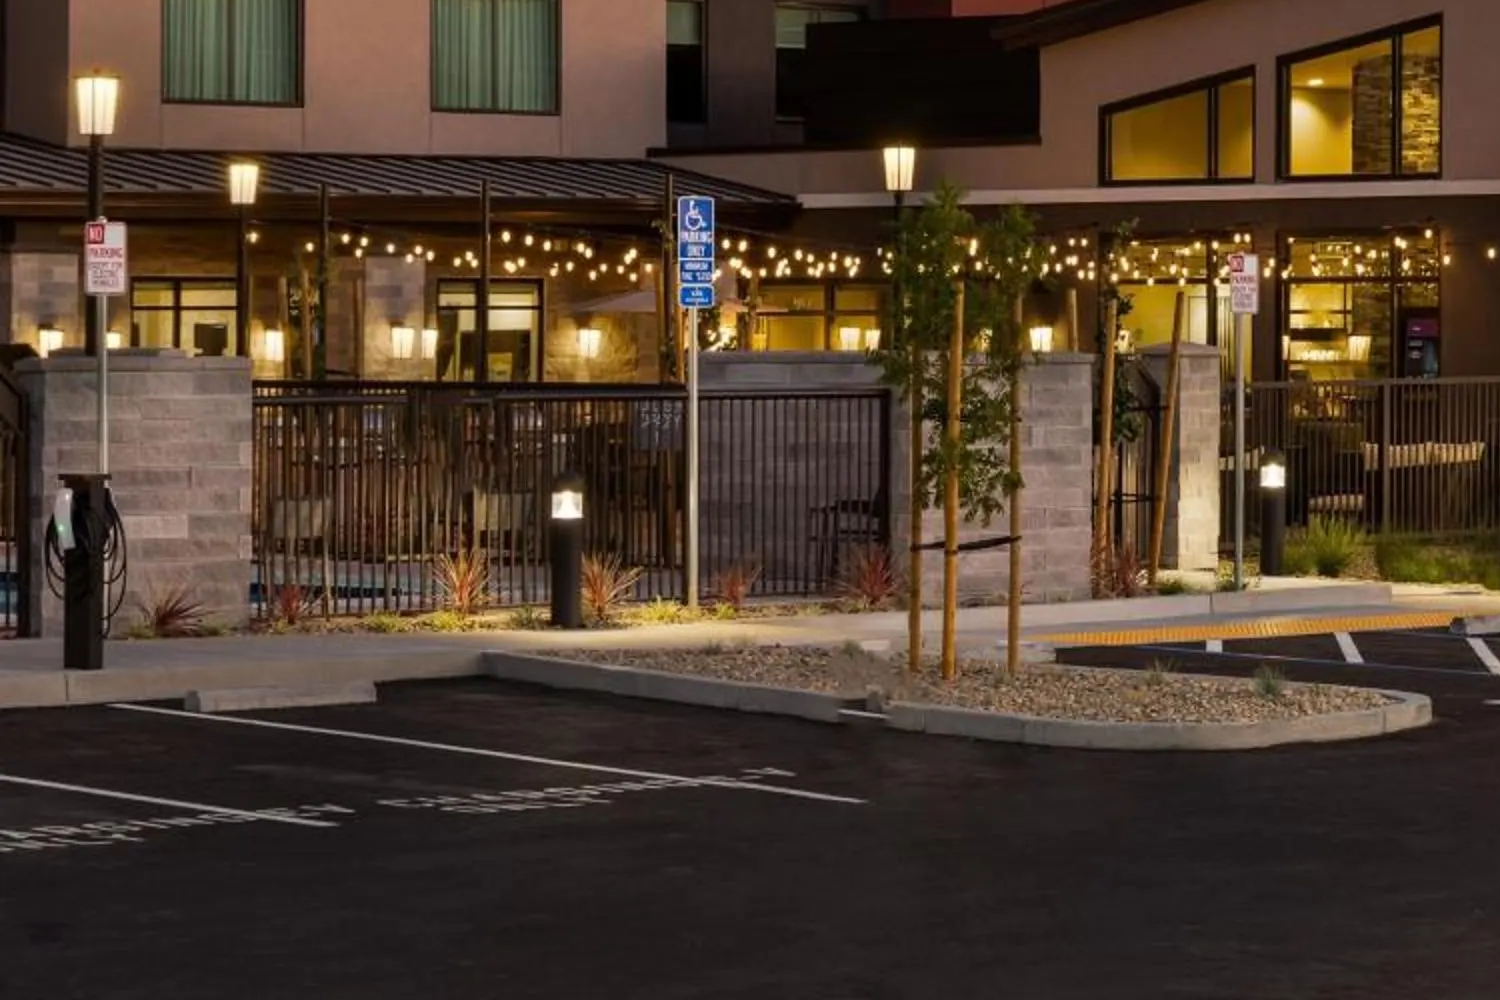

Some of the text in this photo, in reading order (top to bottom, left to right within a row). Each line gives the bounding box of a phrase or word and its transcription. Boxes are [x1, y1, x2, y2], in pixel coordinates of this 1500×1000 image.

[89, 226, 103, 241] NO
[680, 231, 712, 242] PARKING
[89, 247, 123, 258] PARKING
[0, 813, 257, 840] ARGING
